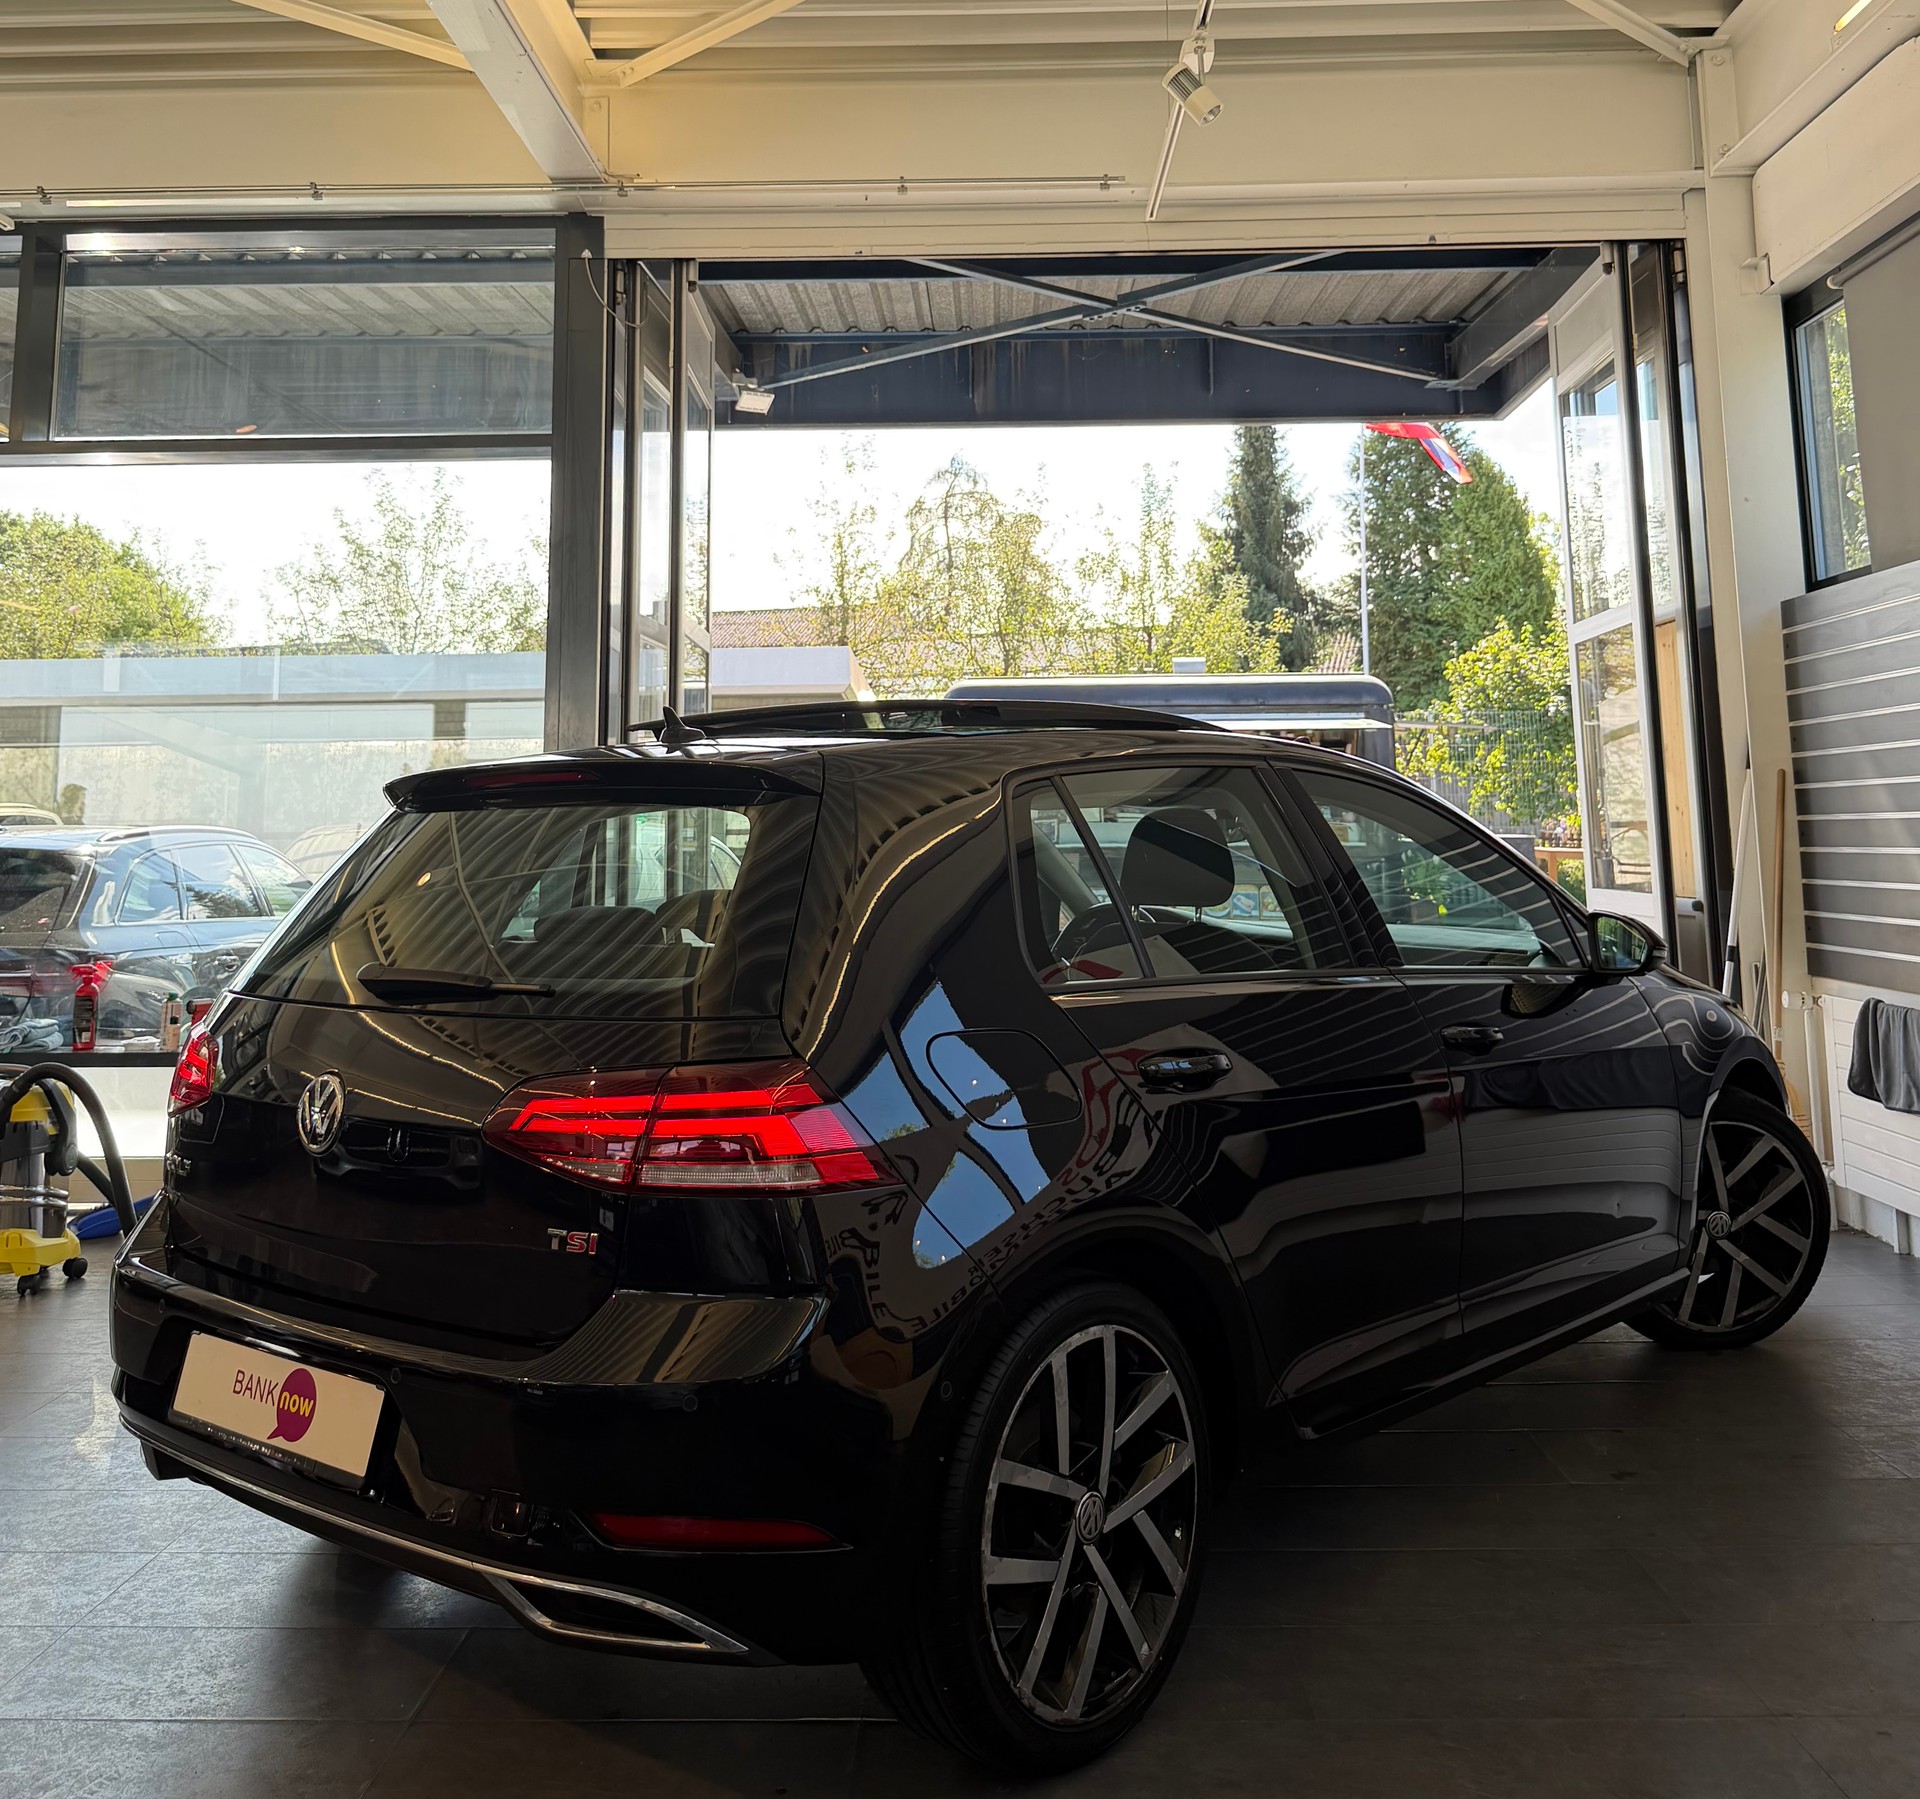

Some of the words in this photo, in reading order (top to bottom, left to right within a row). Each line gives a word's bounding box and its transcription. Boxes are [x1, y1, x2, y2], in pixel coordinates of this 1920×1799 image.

[547, 1227, 599, 1255] TSI
[232, 1369, 279, 1407] BANK
[279, 1391, 314, 1418] now
